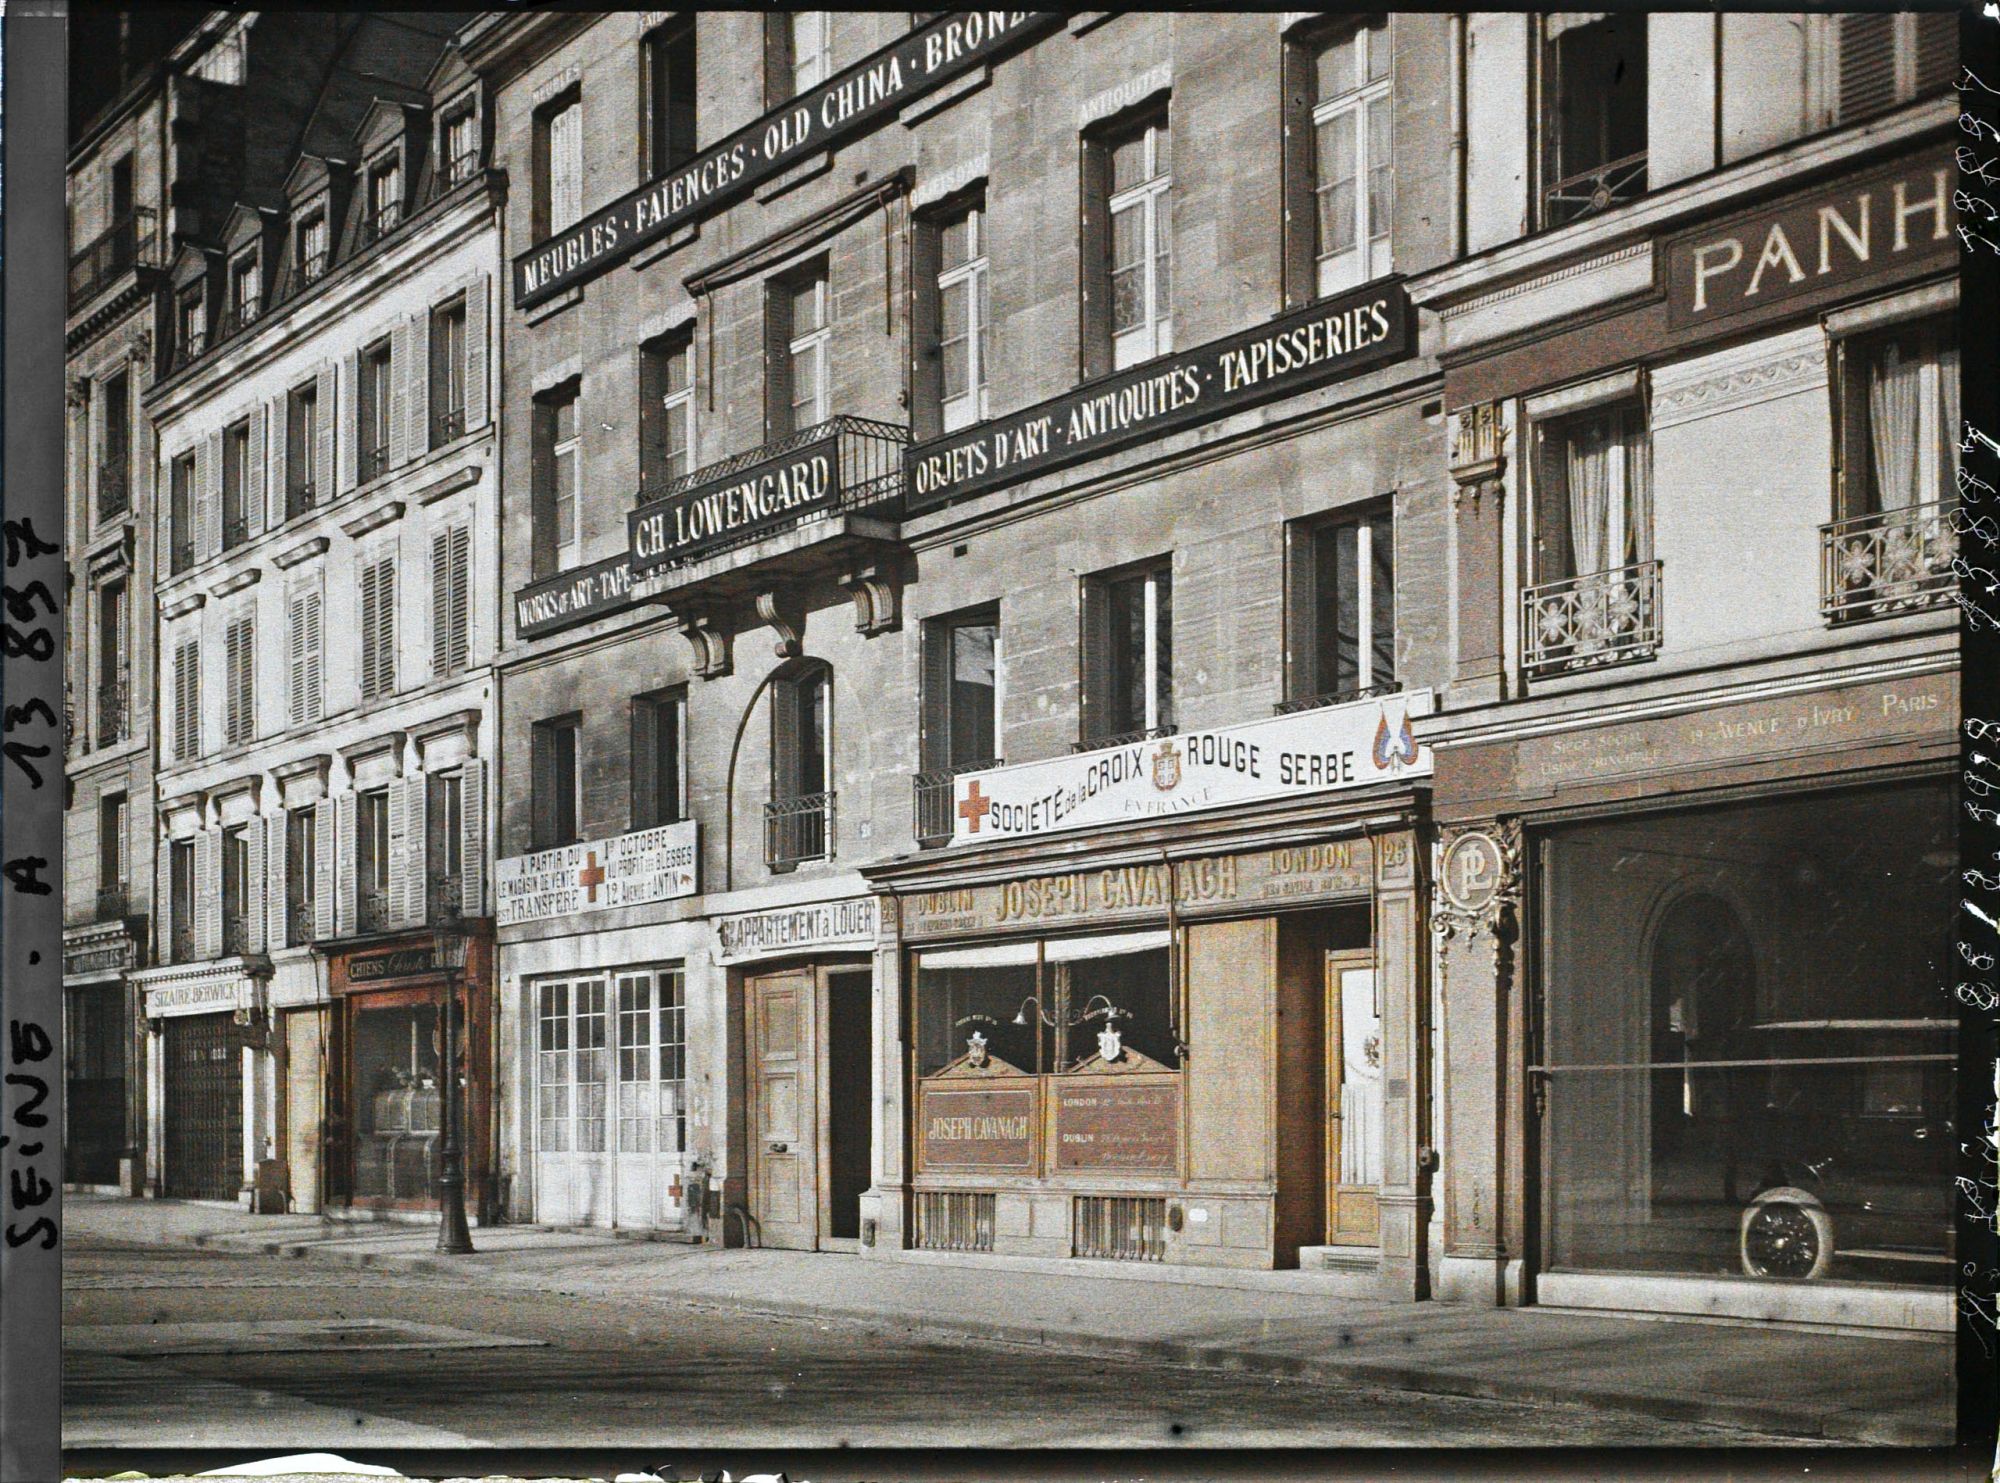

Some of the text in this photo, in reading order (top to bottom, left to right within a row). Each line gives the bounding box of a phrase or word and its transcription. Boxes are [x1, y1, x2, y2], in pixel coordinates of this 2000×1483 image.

[523, 11, 1037, 295] MEUBLES FAÏENCES OLD CHINA BRON
[1692, 170, 1949, 313] PANH
[916, 300, 1389, 494] OBJETS D'ART ANTIQUITÉS TAPISSERIES
[676, 455, 829, 546] LOWENGARD
[518, 590, 557, 629] WORKS
[570, 578, 594, 611] ART
[599, 564, 632, 601] TAPE
[1883, 693, 1938, 716] PARIS
[991, 785, 1064, 833] SOCIÉTÉ
[1087, 747, 1143, 796] CROIX
[1188, 736, 1260, 779] ROUGE
[1281, 750, 1355, 785] SERBE
[620, 829, 667, 857] OCTOBRE
[1269, 843, 1353, 875] LONDON
[4, 853, 52, 897] A
[995, 871, 1089, 922] JOSEPH
[736, 909, 822, 948] APPARTEMENT
[833, 901, 873, 937] LOUER
[929, 1116, 1029, 1140] JOSEPH CAVANAGH
